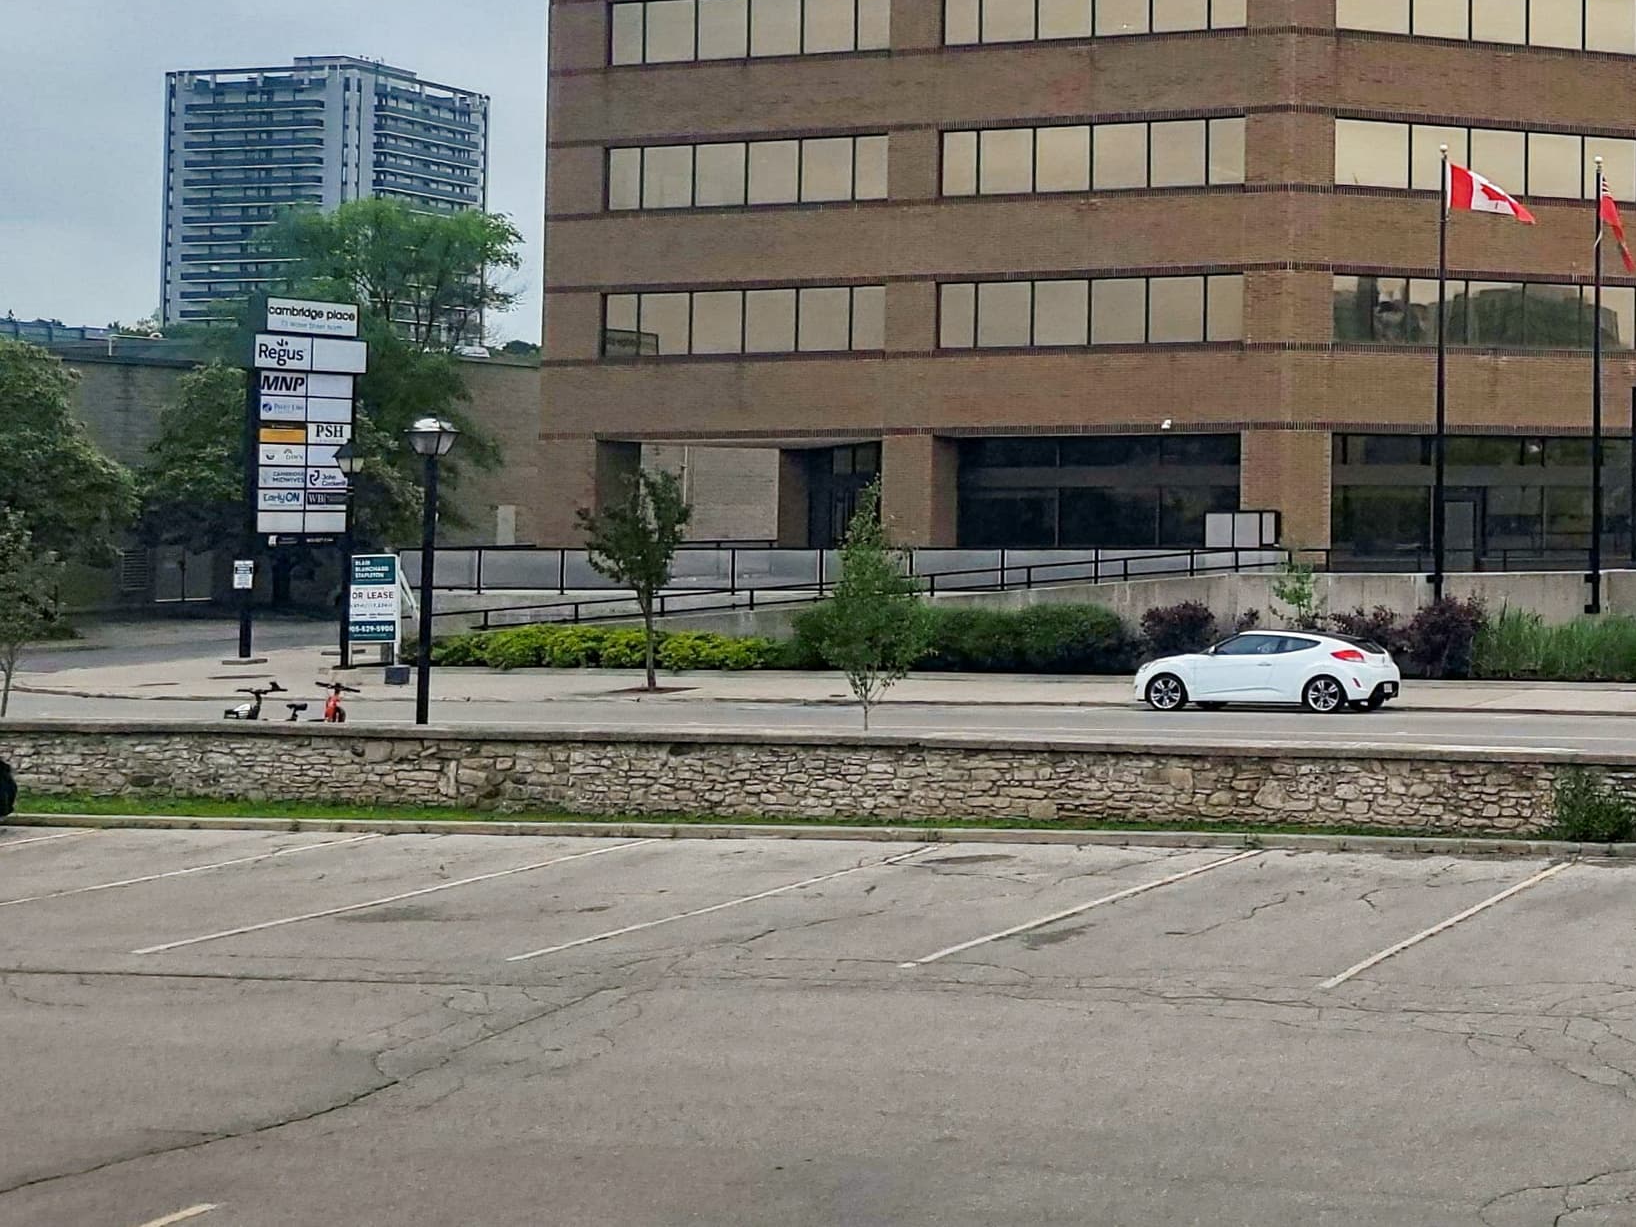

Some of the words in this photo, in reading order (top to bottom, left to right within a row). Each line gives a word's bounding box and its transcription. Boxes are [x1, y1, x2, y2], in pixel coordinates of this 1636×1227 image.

[268, 303, 324, 320] cambridge
[326, 309, 356, 321] place
[258, 342, 304, 367] Regus
[261, 375, 305, 392] MNP
[316, 424, 344, 438] PSH
[366, 591, 394, 600] LEASE
